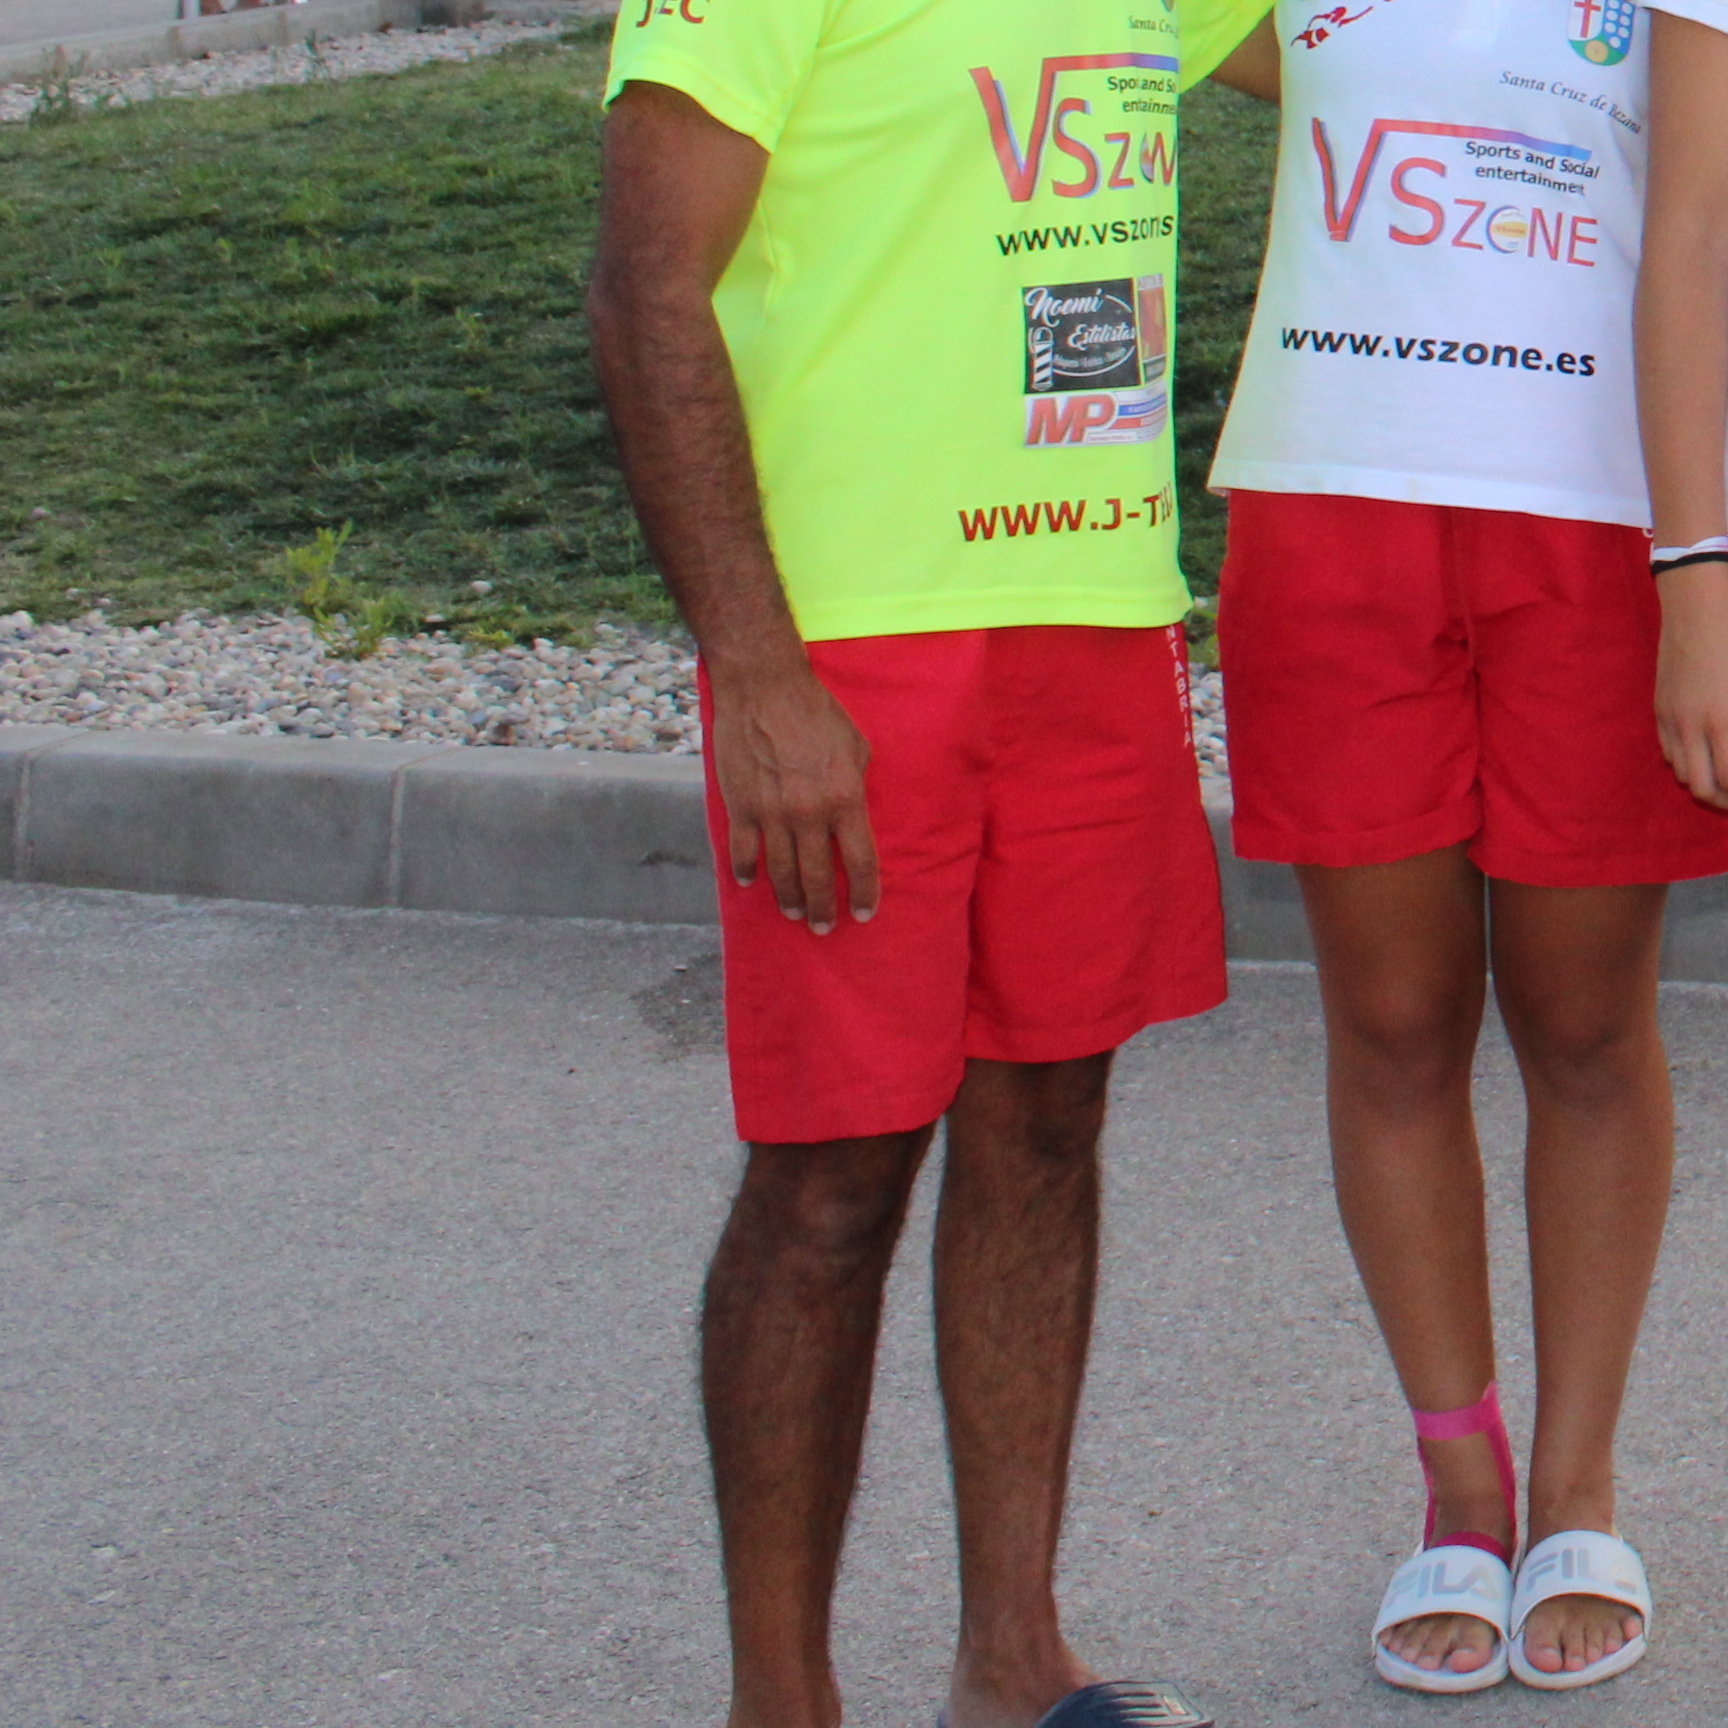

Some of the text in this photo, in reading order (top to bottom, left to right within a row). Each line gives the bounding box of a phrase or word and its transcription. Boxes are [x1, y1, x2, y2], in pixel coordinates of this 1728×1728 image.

[1141, 76, 1165, 93] and
[1499, 70, 1643, 135] Santa Cruz de Bezana
[1465, 140, 1601, 179] Sports and Social
[1067, 322, 1136, 352] Estilistas
[1281, 327, 1597, 378] www.vszone.es
[1026, 393, 1117, 445] MP
[1384, 1560, 1500, 1610] FILA
